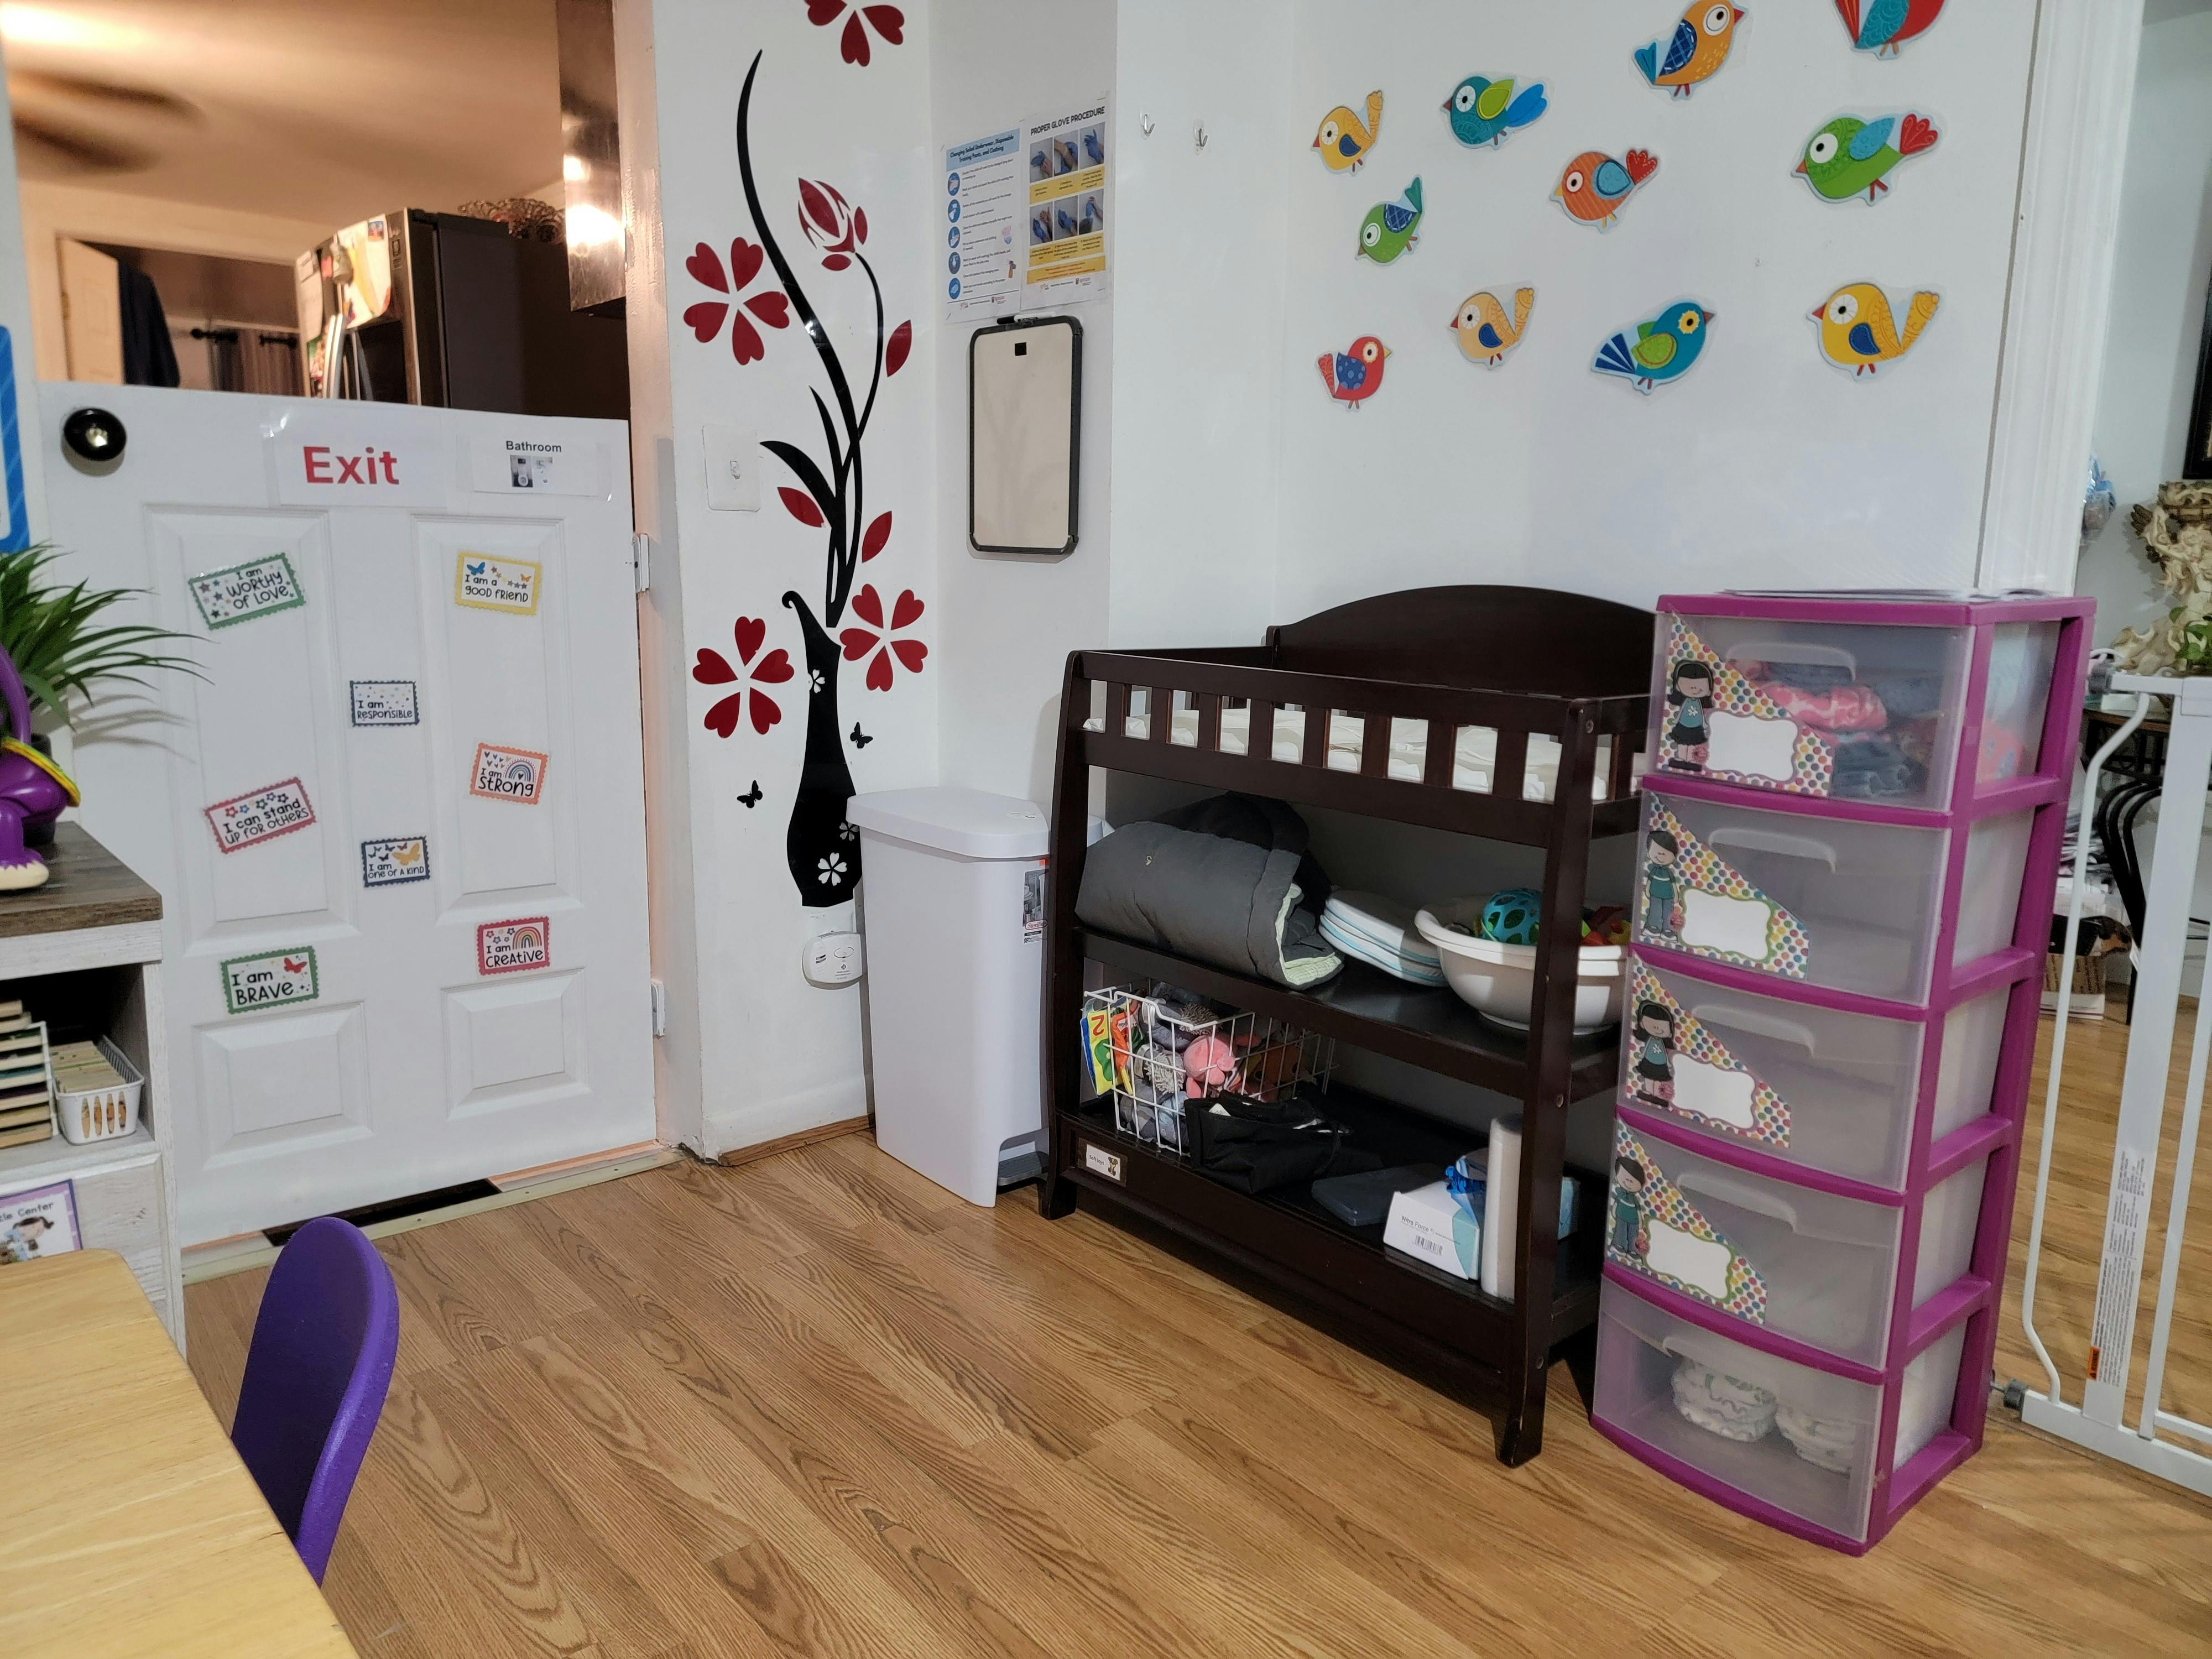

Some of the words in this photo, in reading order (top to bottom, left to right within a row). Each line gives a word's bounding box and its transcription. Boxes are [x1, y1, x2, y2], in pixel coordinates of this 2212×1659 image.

[1030, 123, 1051, 136] PROPER
[1051, 117, 1070, 129] GLOVE
[1071, 106, 1105, 123] PROCEDURE
[506, 441, 561, 453] Bathroom
[304, 446, 399, 484] Exit
[236, 572, 243, 580] I
[246, 568, 263, 577] am
[473, 577, 488, 585] am
[358, 700, 364, 708] I
[223, 823, 232, 833] I
[236, 815, 260, 829] can
[263, 798, 301, 819] stand
[231, 974, 241, 986] I
[247, 972, 273, 983] am
[1091, 1014, 1105, 1036] 2
[18, 1202, 54, 1217] Center
[1401, 1215, 1413, 1225] Nitra
[1415, 1222, 1429, 1232] Force
